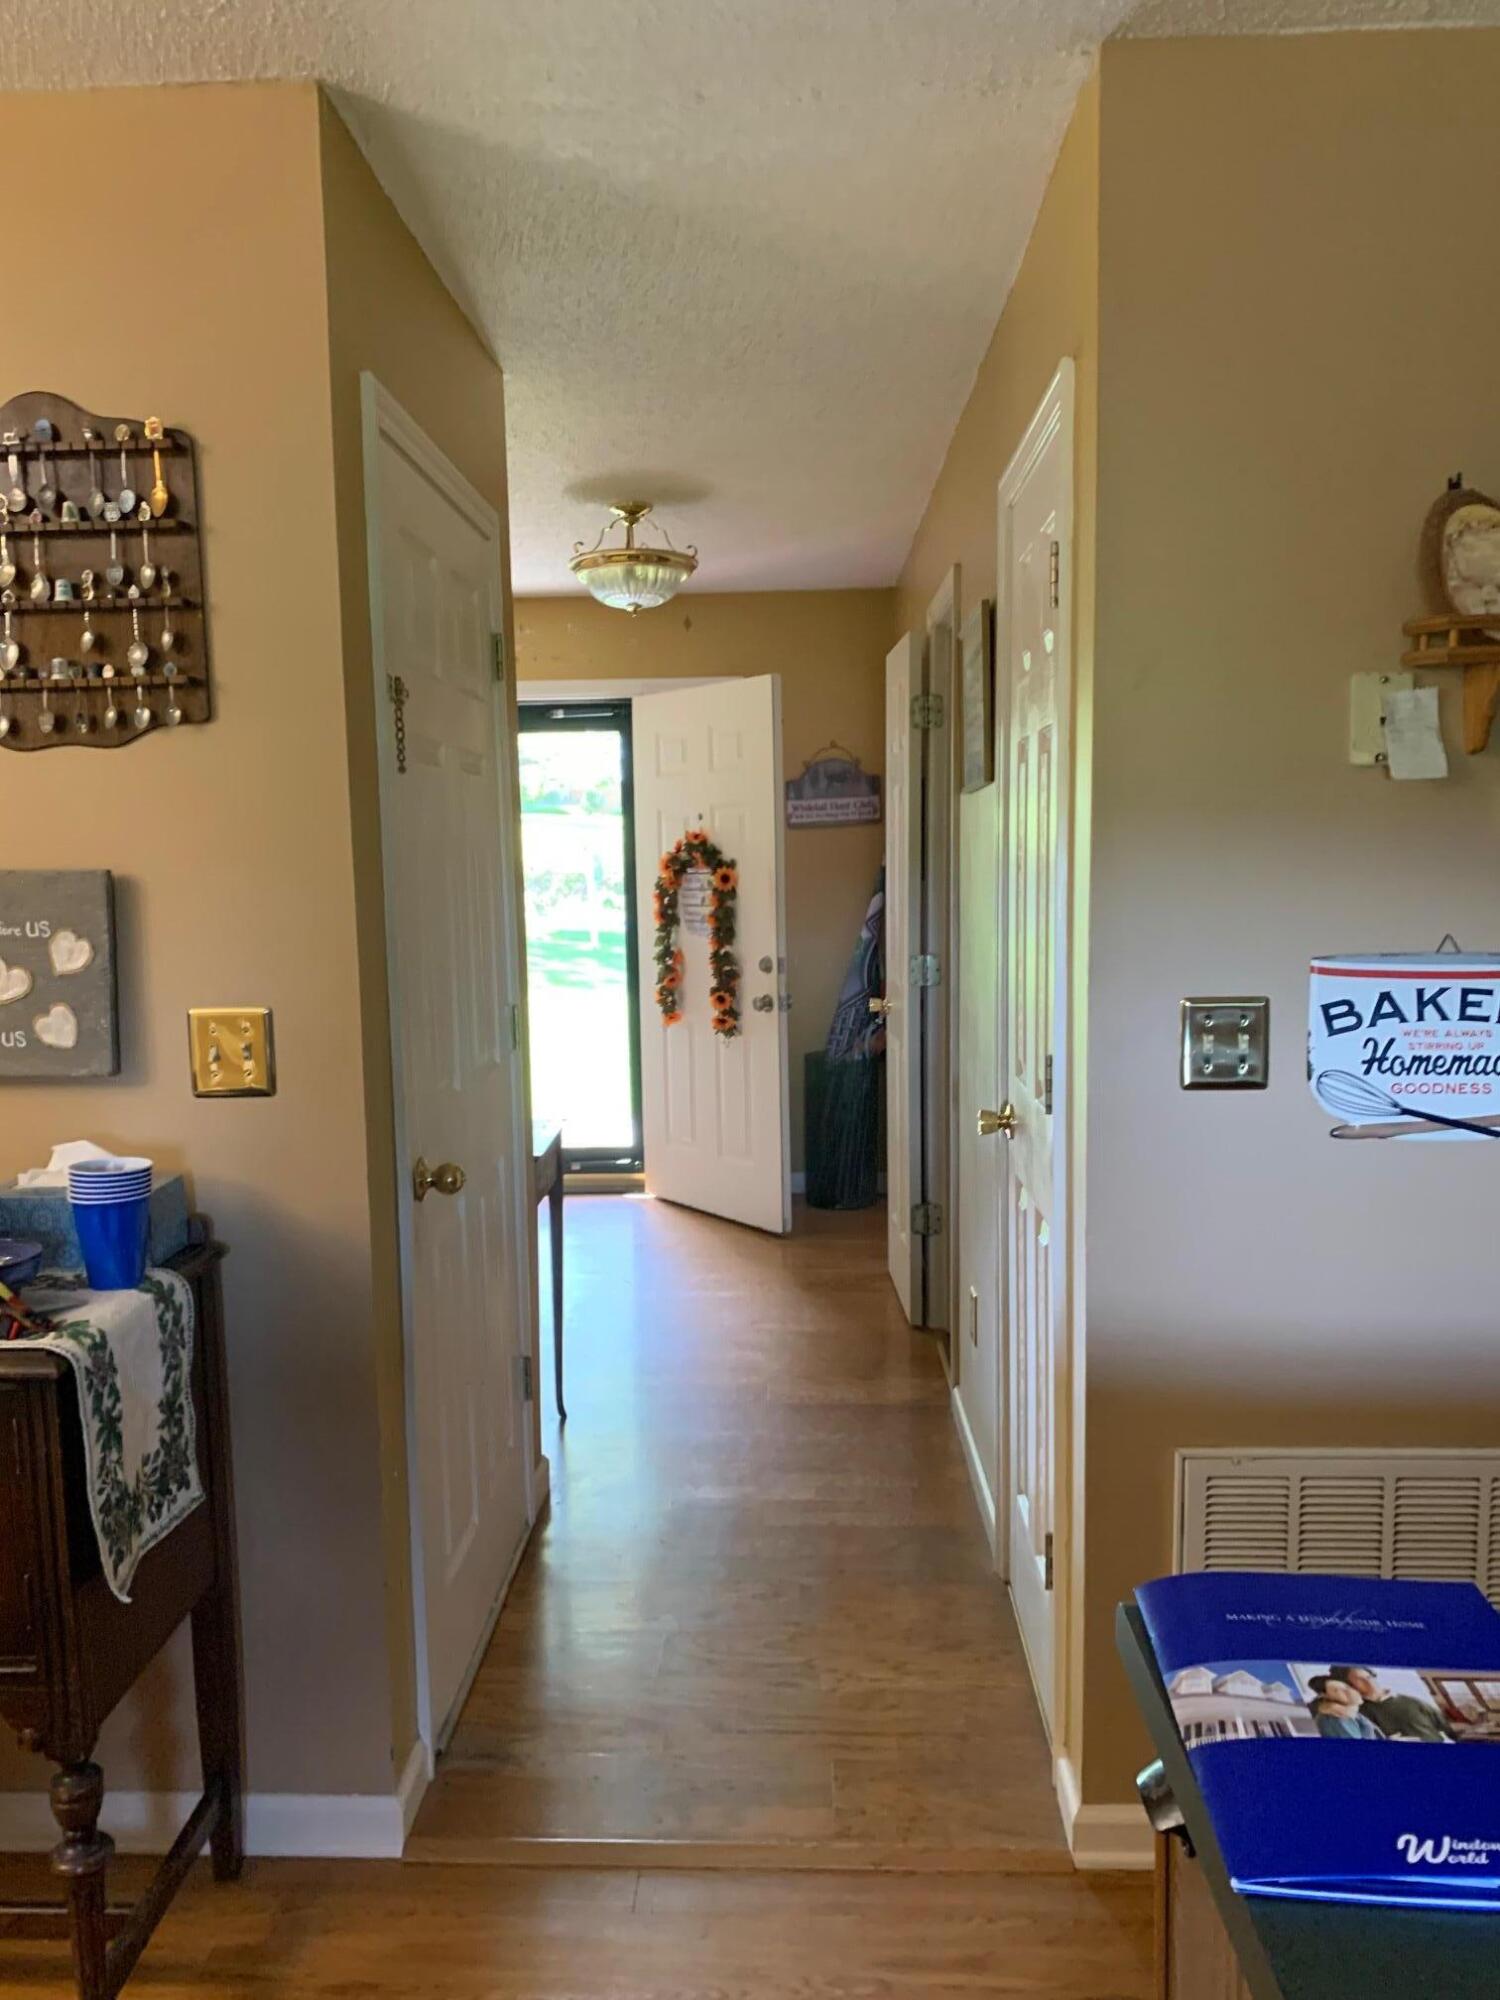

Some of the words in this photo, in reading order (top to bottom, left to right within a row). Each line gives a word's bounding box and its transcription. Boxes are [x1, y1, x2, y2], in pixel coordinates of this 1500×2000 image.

[1320, 986, 1500, 1037] BAKE
[1402, 1029, 1439, 1037] WE'RE
[1444, 1029, 1493, 1038] ALWAYS
[1467, 1042, 1485, 1050] UP
[1390, 1082, 1493, 1094] GOODNESS
[1225, 1613, 1281, 1622] MAKING
